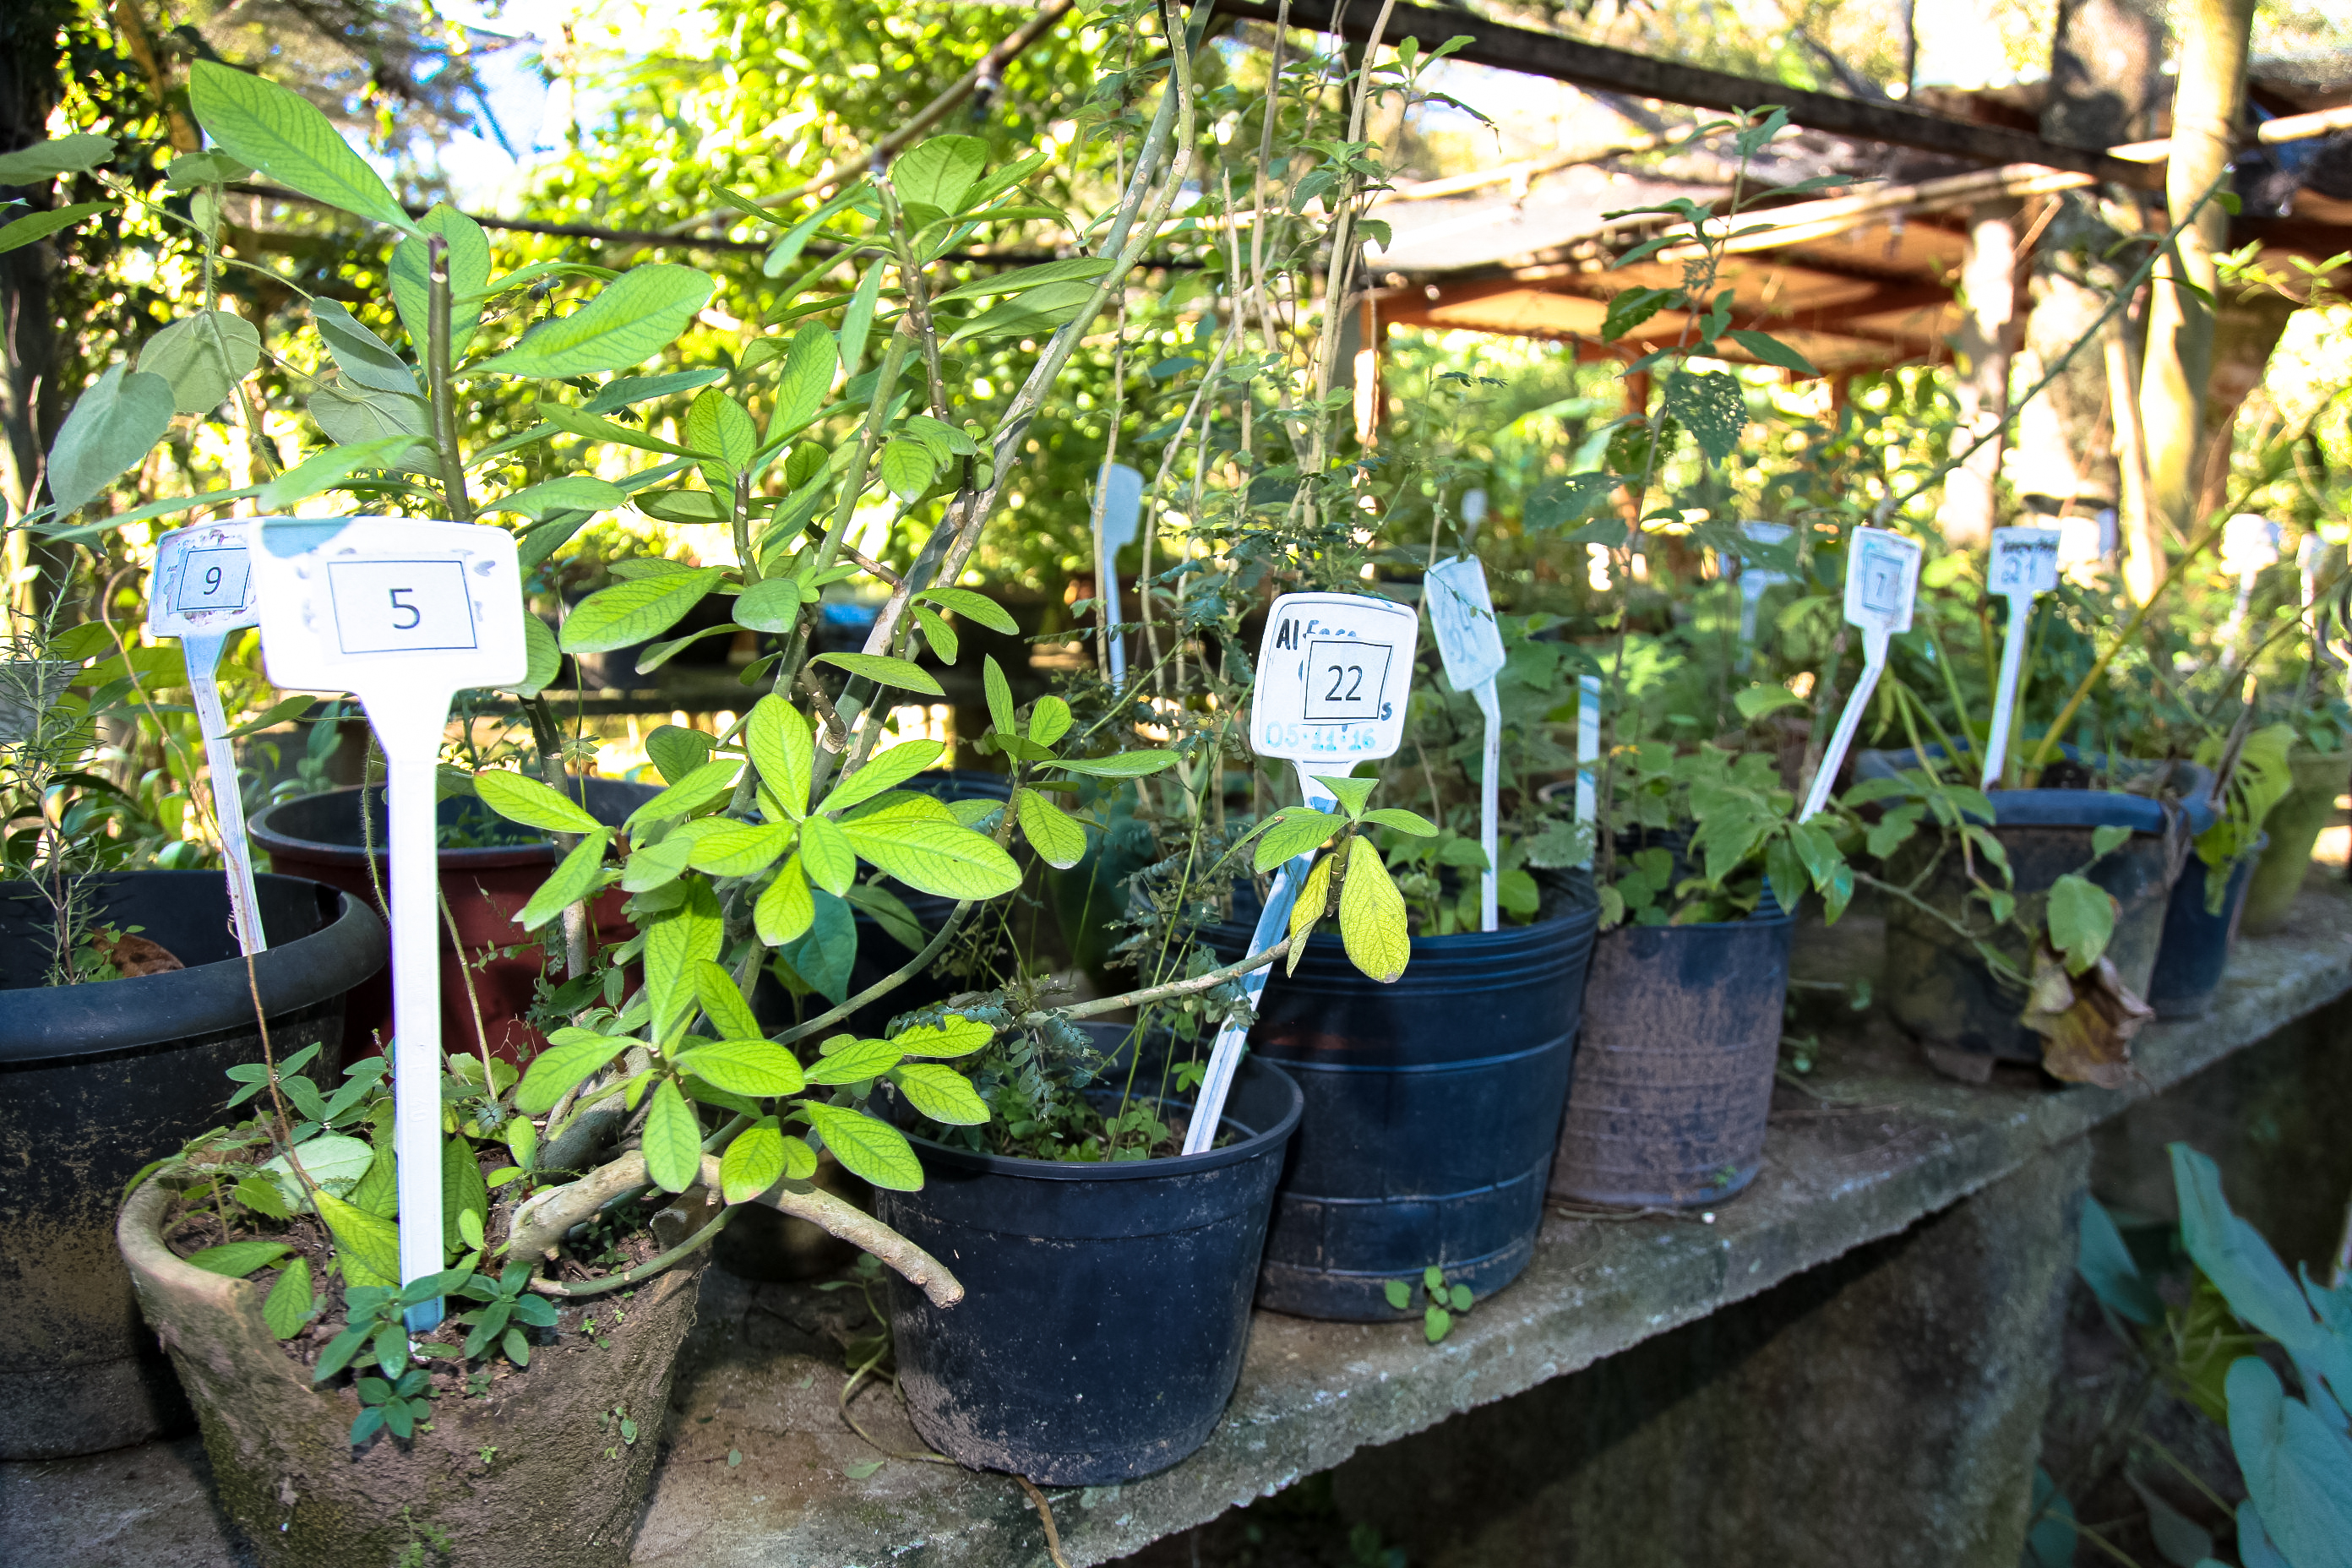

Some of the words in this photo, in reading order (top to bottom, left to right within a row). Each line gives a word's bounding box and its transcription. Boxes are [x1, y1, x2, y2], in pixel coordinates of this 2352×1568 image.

[203, 566, 222, 596] 9
[388, 587, 421, 630] 5
[1325, 665, 1363, 701] 22
